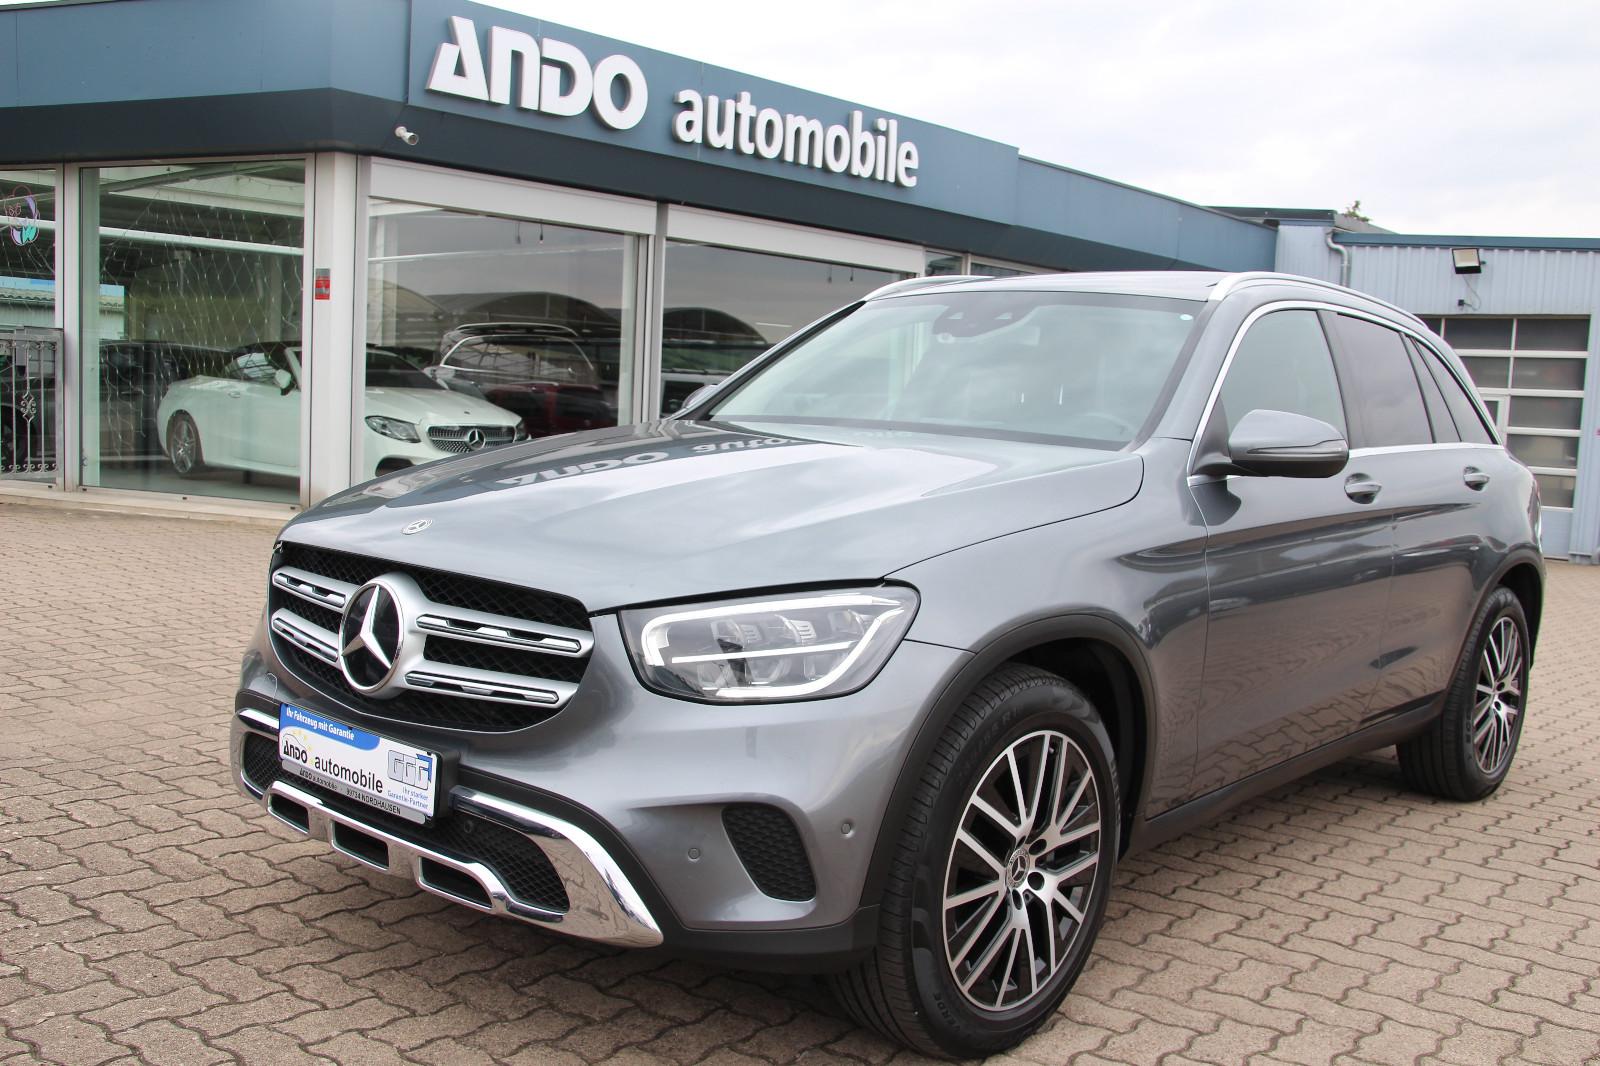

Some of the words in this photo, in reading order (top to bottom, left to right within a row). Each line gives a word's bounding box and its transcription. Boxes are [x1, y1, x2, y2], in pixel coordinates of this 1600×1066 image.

[425, 15, 648, 130] ANDO
[672, 89, 919, 188] automobile
[286, 706, 294, 718] Ihr
[294, 710, 318, 729] Fahrzeug
[318, 721, 329, 732] mit
[329, 723, 355, 740] Garantie
[284, 740, 308, 763] ANDO
[315, 756, 383, 793] automobile
